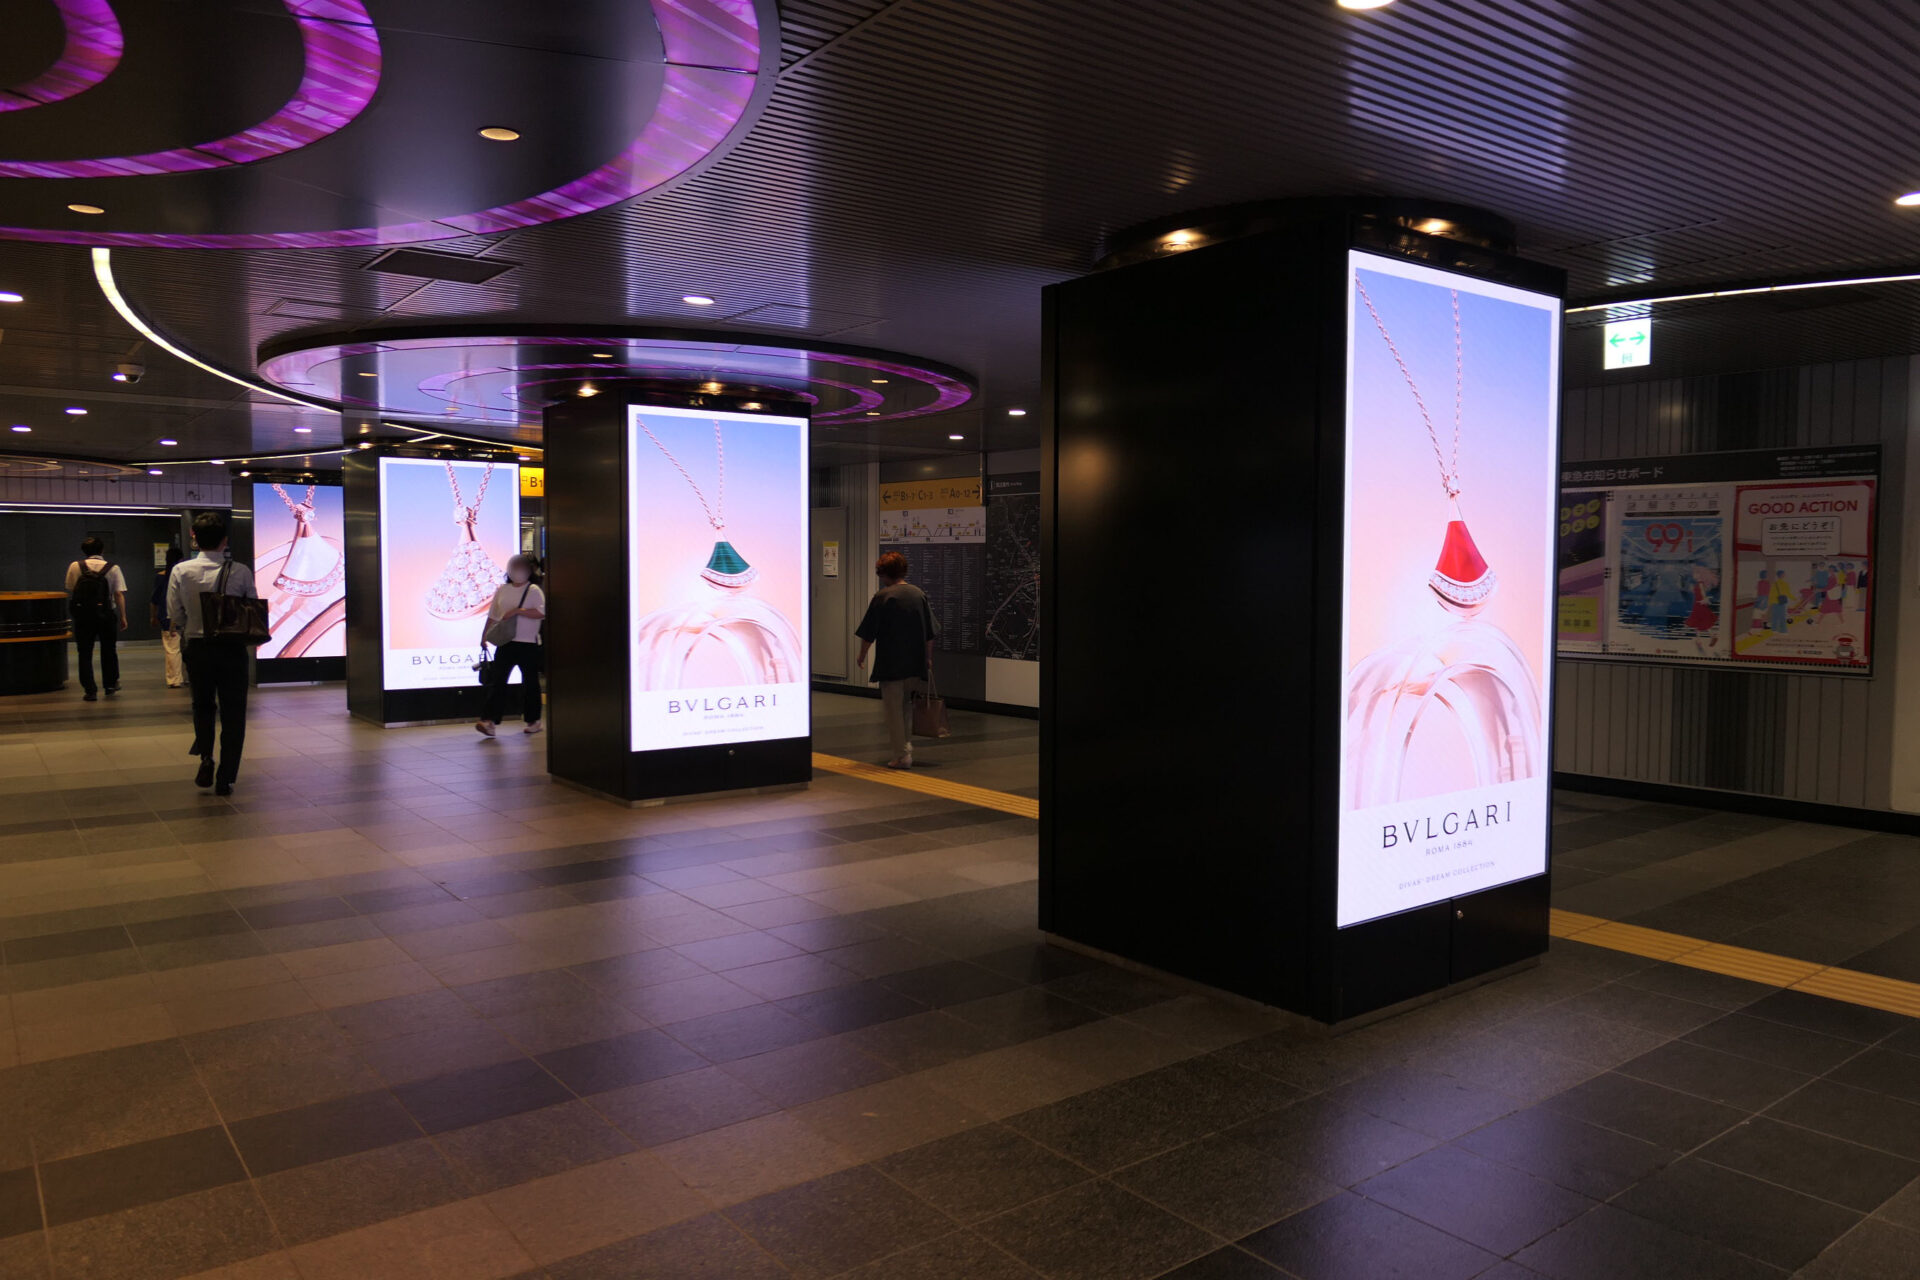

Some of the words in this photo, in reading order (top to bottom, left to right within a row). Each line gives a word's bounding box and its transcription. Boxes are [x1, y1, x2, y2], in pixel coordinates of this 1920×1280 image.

[1748, 502, 1794, 514] GOOD
[1798, 500, 1858, 513] ACTION
[668, 694, 777, 713] BVLGARI
[1382, 801, 1511, 849] BVLGARI
[1425, 845, 1450, 857] ROMA
[1453, 840, 1473, 850] 1884
[1426, 872, 1451, 884] DREAM
[1452, 861, 1496, 877] COLLECTION
